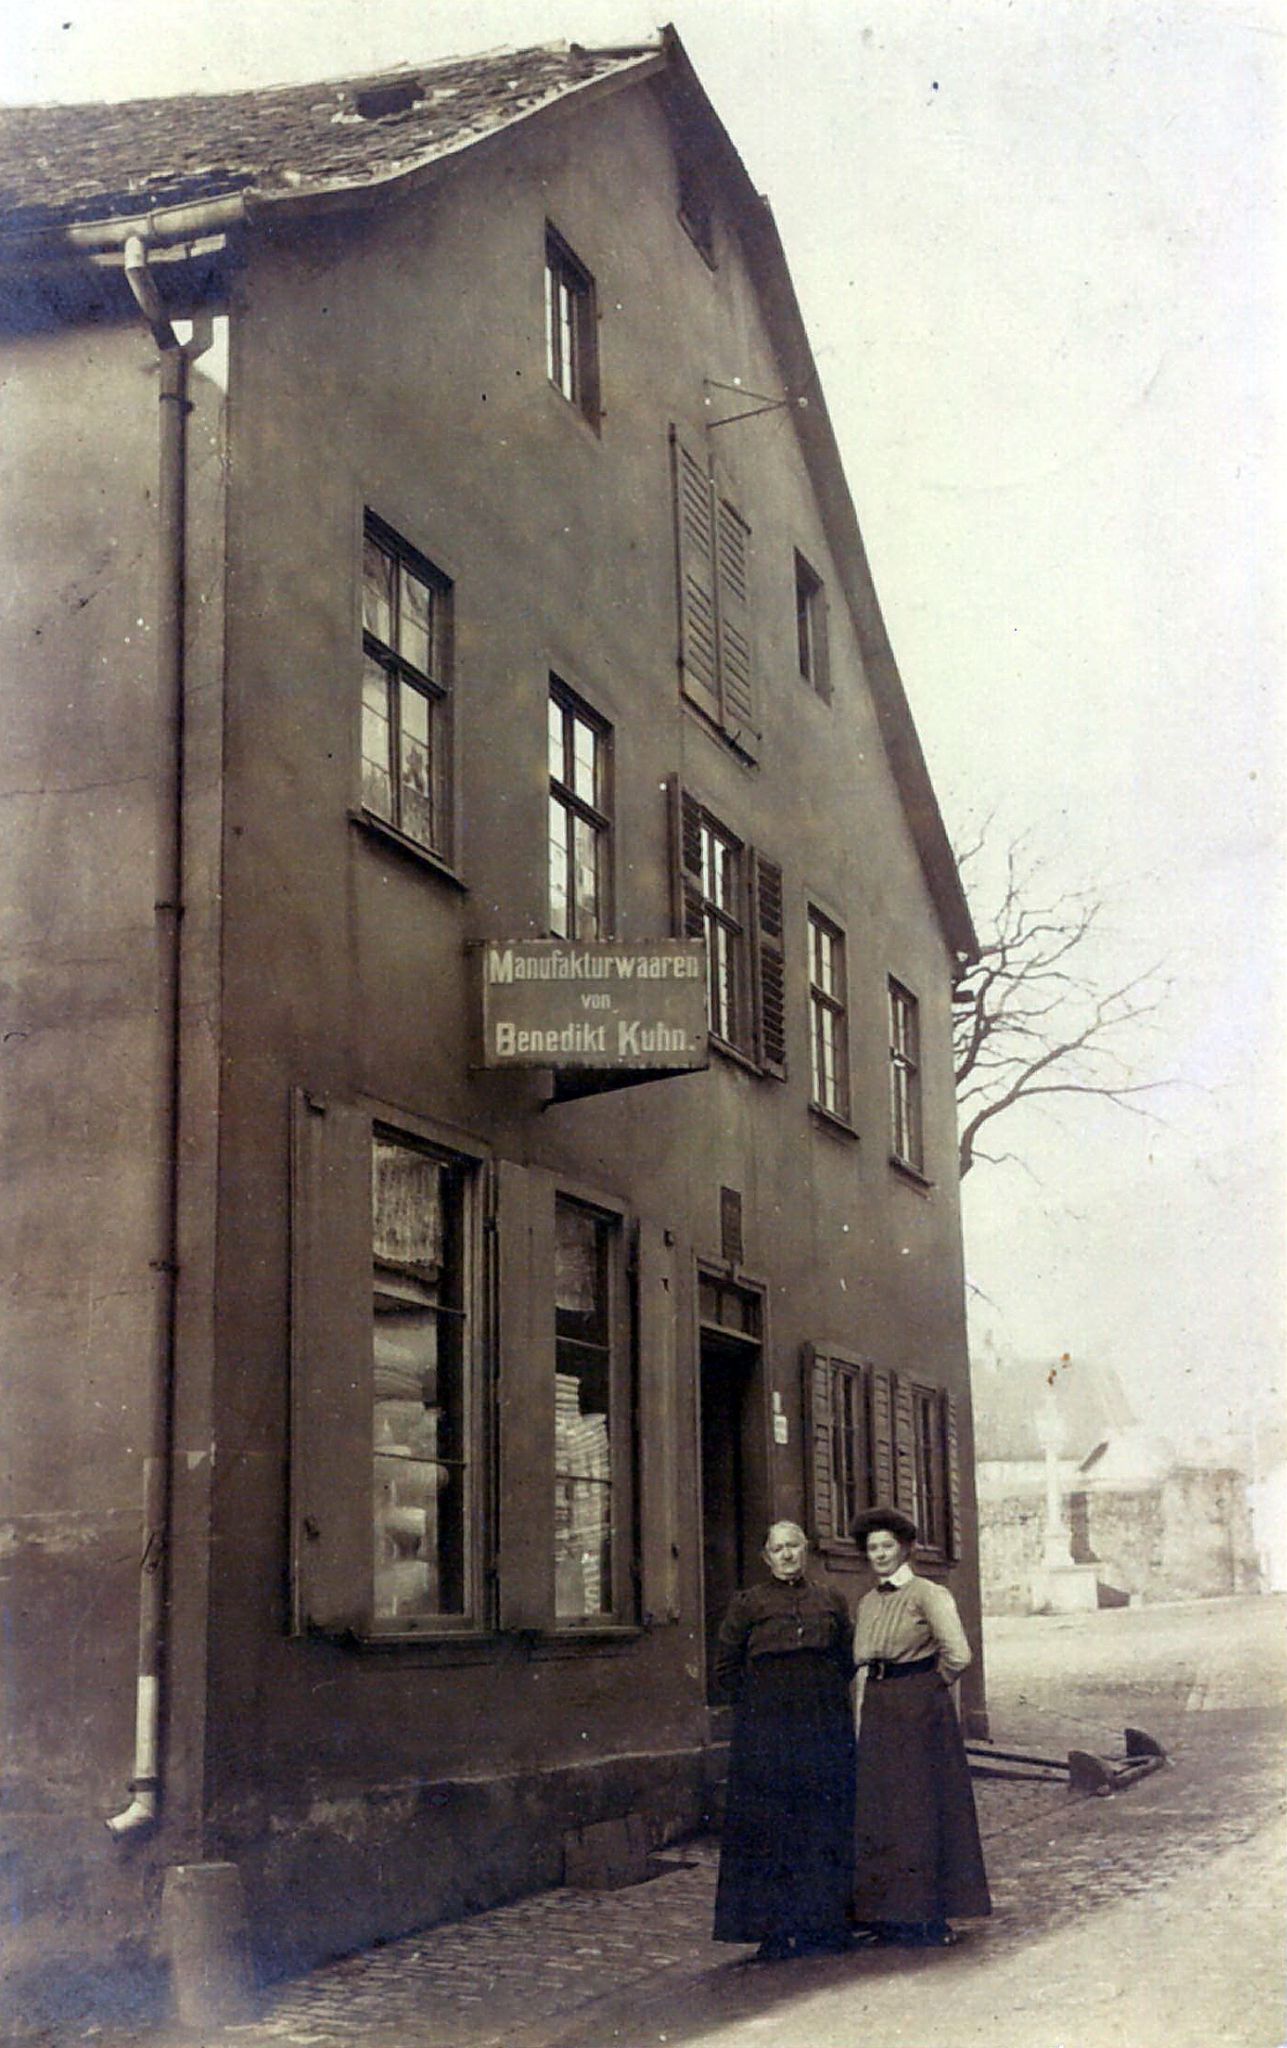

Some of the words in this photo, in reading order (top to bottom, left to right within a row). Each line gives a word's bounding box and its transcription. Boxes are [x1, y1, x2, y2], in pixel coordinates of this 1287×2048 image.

[490, 950, 699, 984] Manufakturwaaren
[581, 993, 611, 1009] von
[496, 1022, 606, 1056] Benedikt
